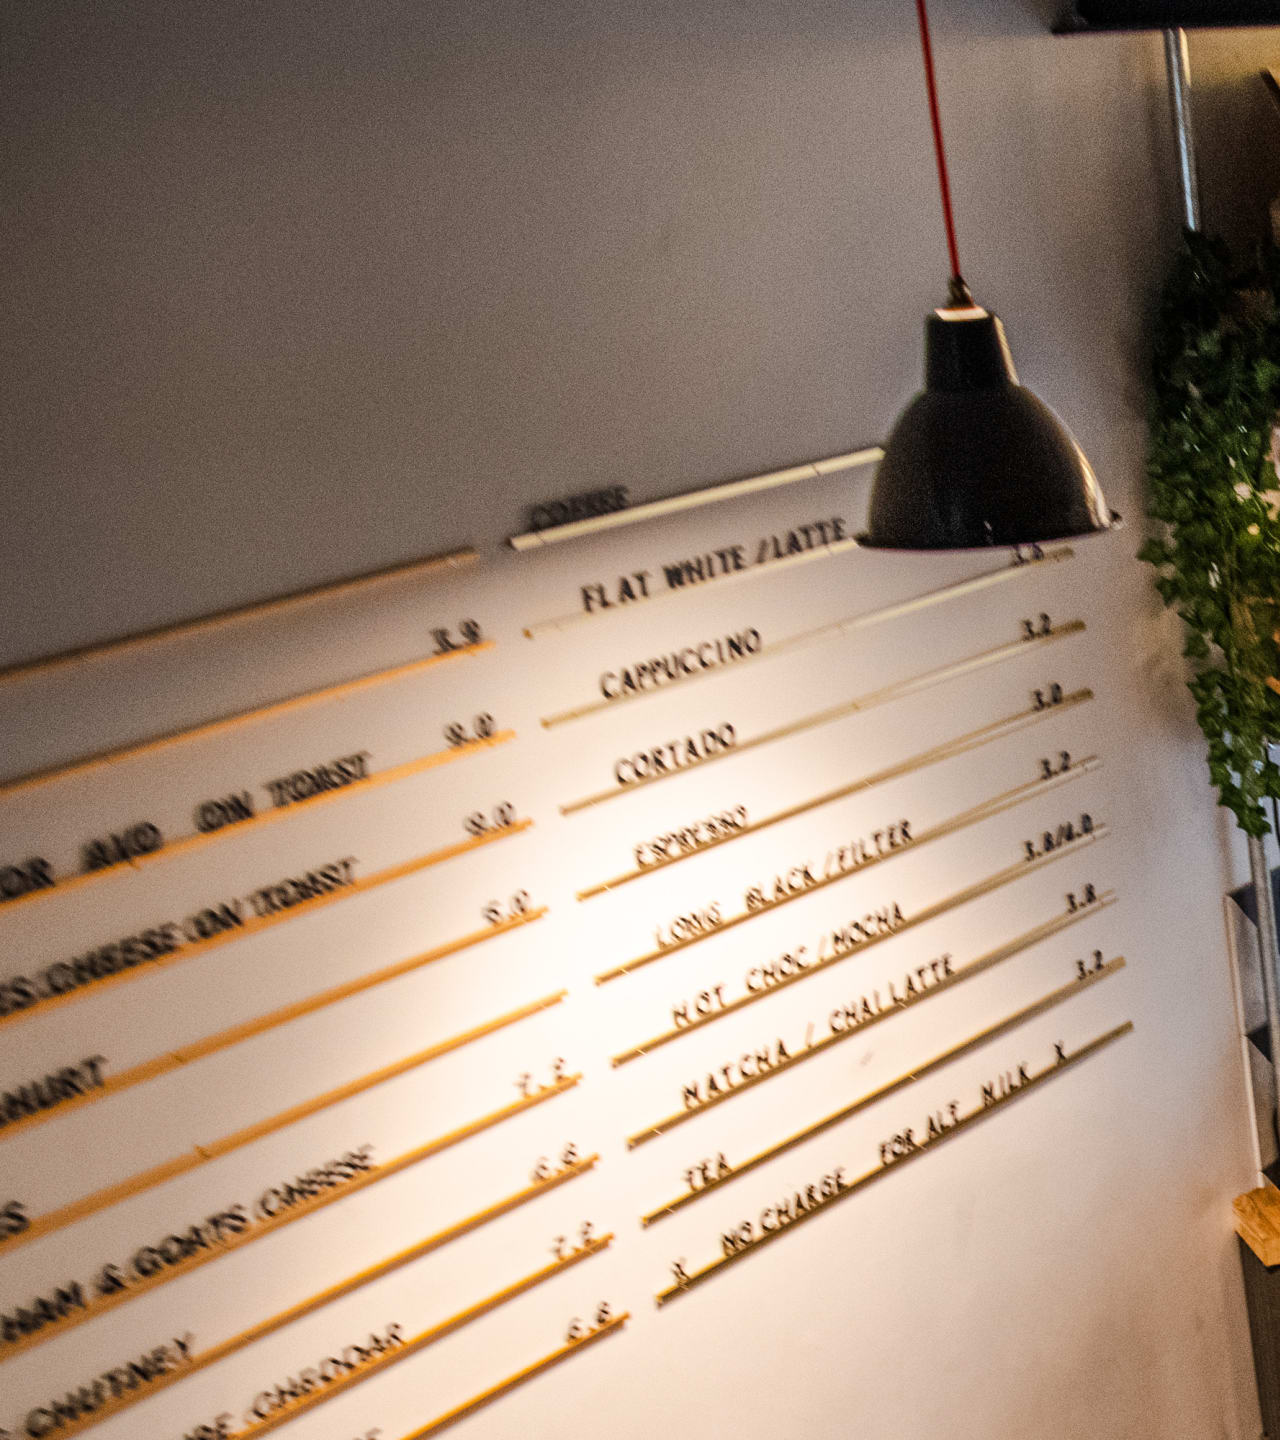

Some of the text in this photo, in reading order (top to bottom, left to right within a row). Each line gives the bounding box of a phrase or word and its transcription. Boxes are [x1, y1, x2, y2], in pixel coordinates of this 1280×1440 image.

[580, 569, 652, 613] FLAT
[662, 544, 746, 590] WHITE
[600, 626, 762, 700] CAPPUCCINO
[615, 721, 737, 788] CORTADO
[633, 804, 749, 871] ESPRESSO
[655, 900, 723, 951] LONG
[744, 863, 818, 914] BLACK
[671, 981, 728, 1030] HOT
[746, 944, 809, 994] CHOC
[682, 1036, 791, 1110] MATCHA
[888, 953, 956, 1004] LATTE
[258, 1143, 374, 1219] CHEESE
[682, 1151, 733, 1192] TEA
[720, 1221, 753, 1257] NO
[759, 1165, 849, 1232] CHARGE
[880, 1127, 921, 1166] FOR
[927, 1098, 960, 1141] ALT
[980, 1060, 1032, 1108] MILK
